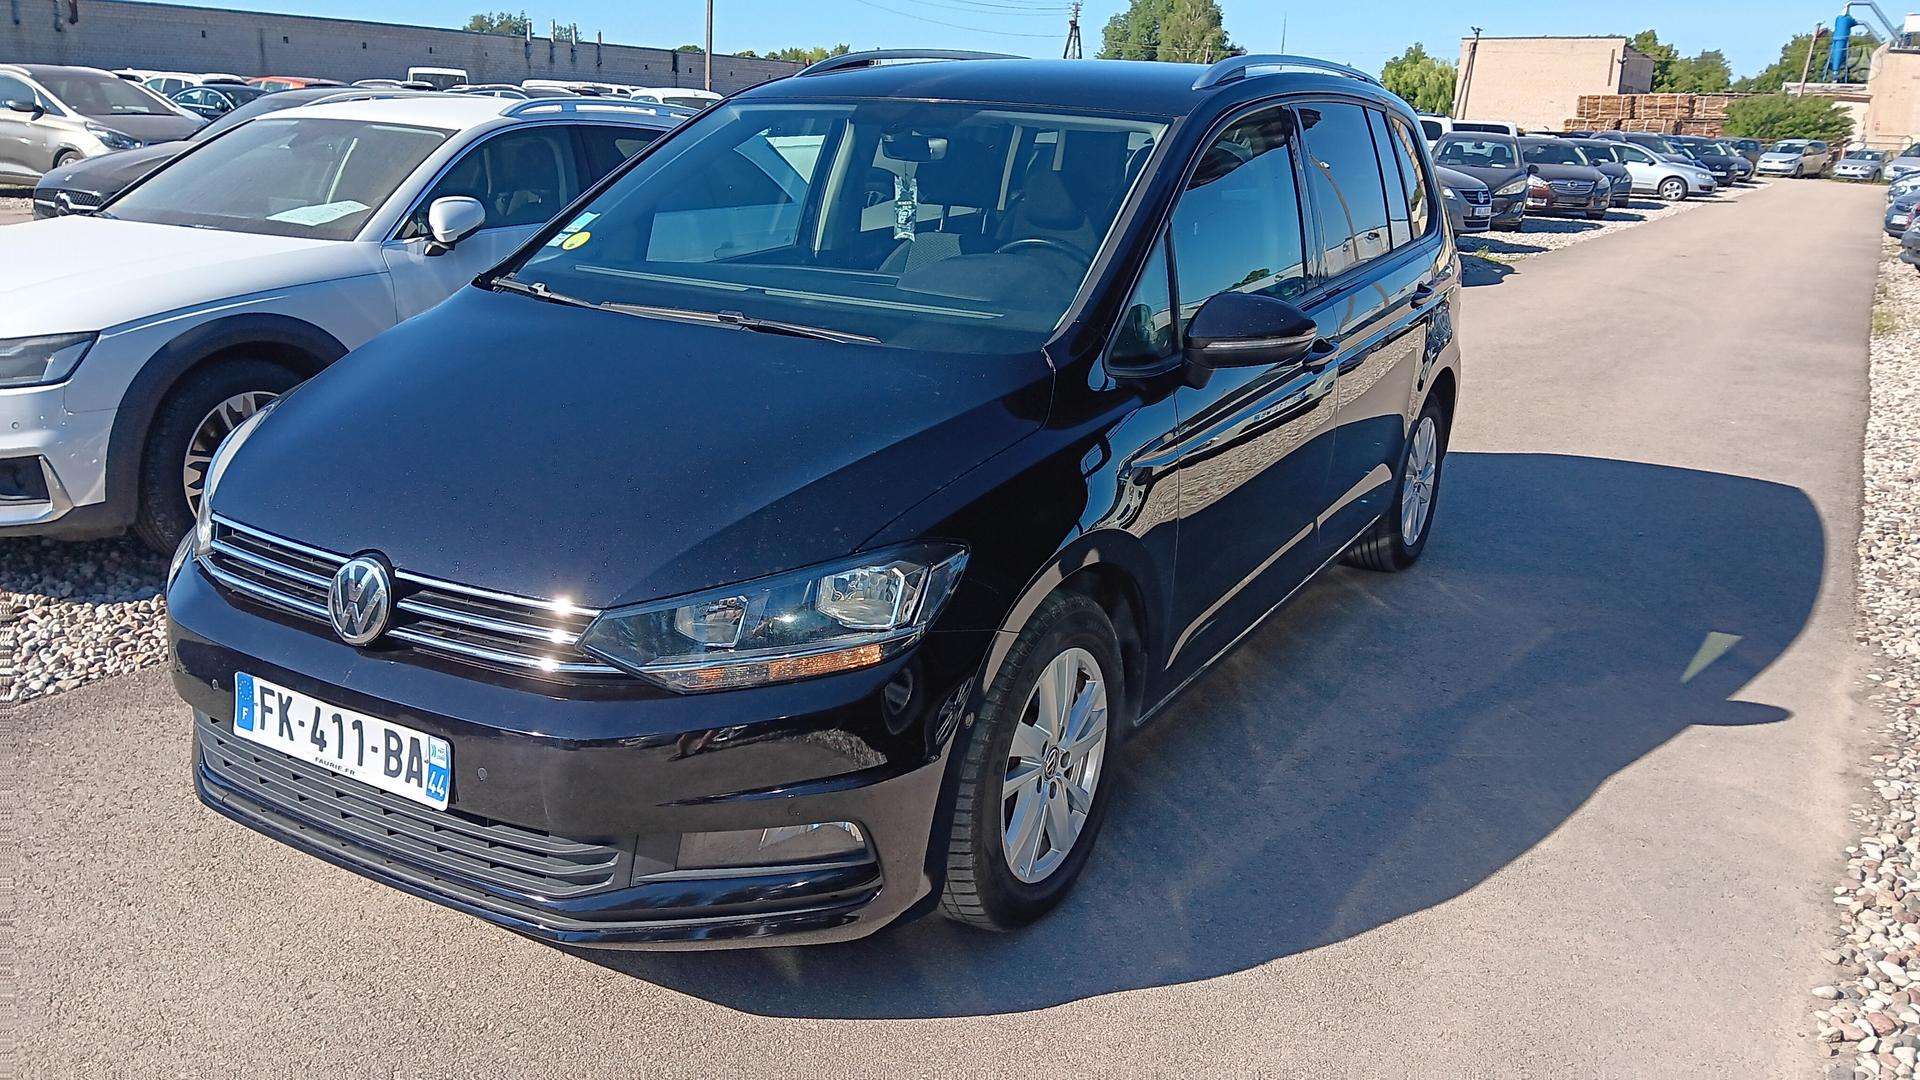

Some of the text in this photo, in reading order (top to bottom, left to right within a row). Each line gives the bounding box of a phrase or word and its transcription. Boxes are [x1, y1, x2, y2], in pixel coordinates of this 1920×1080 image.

[242, 707, 249, 721] F
[259, 685, 423, 788] FK-411-BA
[428, 770, 445, 796] 44
